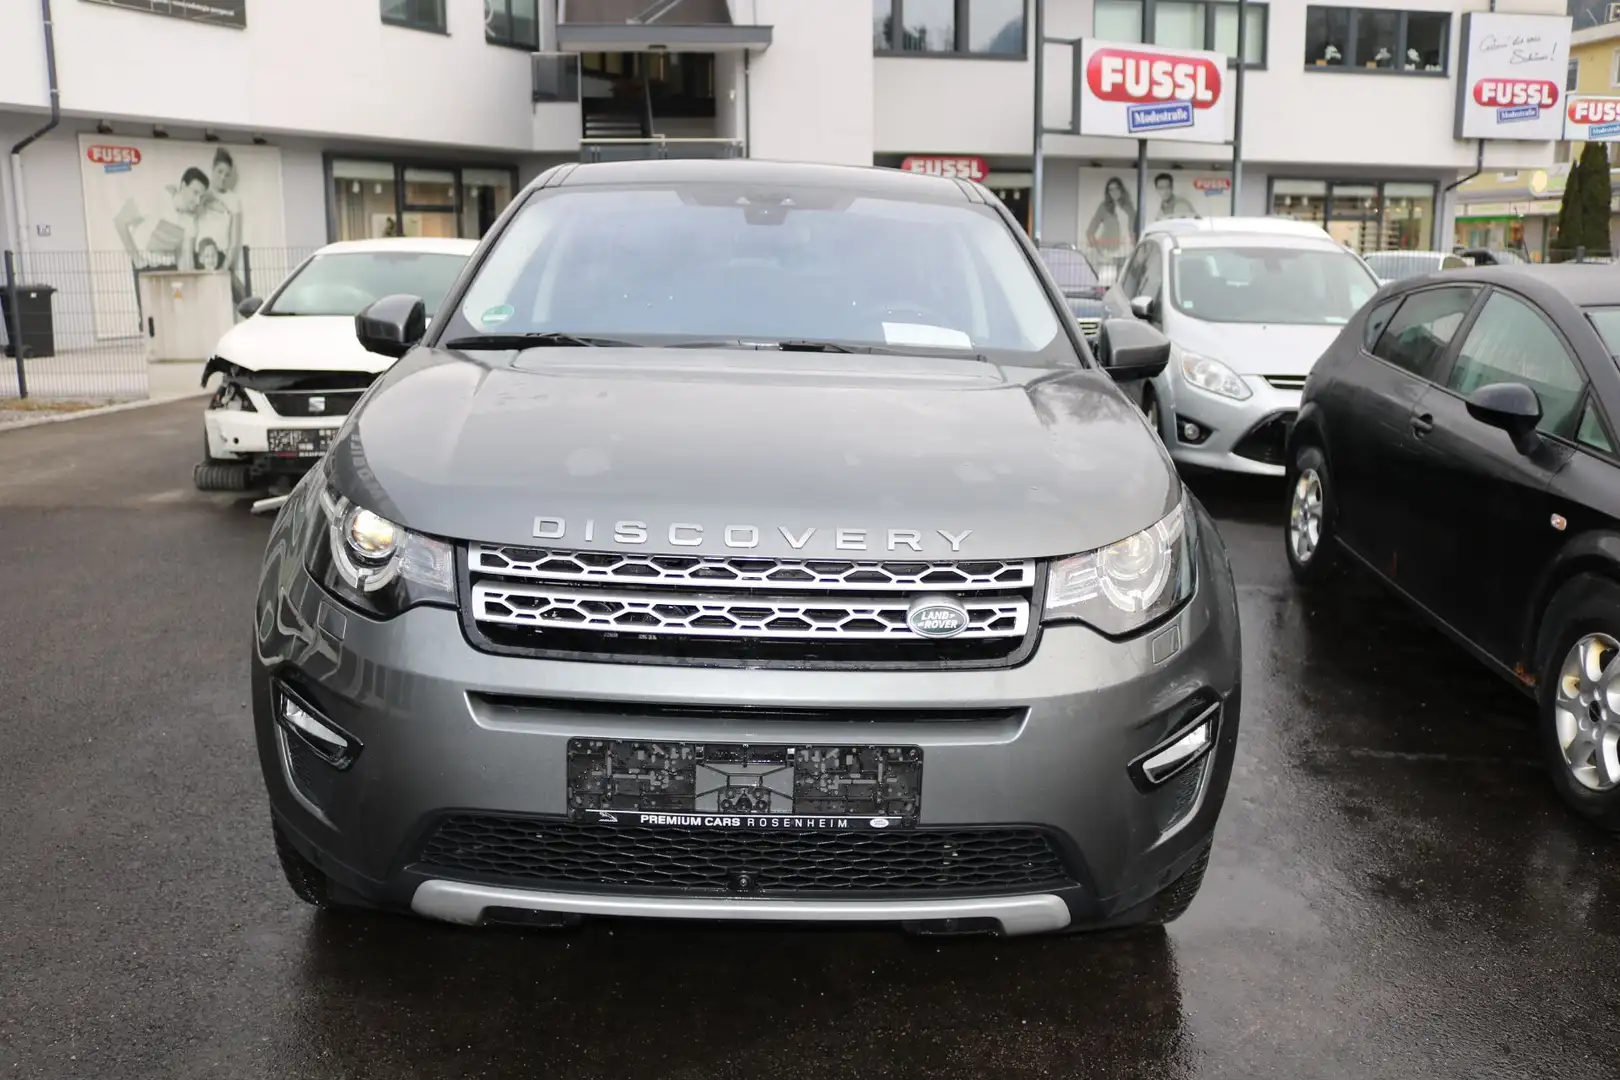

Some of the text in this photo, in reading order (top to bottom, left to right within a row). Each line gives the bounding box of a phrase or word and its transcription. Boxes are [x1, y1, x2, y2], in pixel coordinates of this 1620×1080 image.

[1101, 56, 1213, 101] FUSSL
[1481, 82, 1553, 105] FUSSL
[93, 147, 138, 163] FUSSL
[911, 159, 983, 179] FUSSL
[532, 515, 974, 552] DISCOVERY
[921, 611, 950, 621] LAND
[923, 619, 958, 629] ROVER
[640, 814, 848, 828] PREMIUM CARS ROSENHEIM
